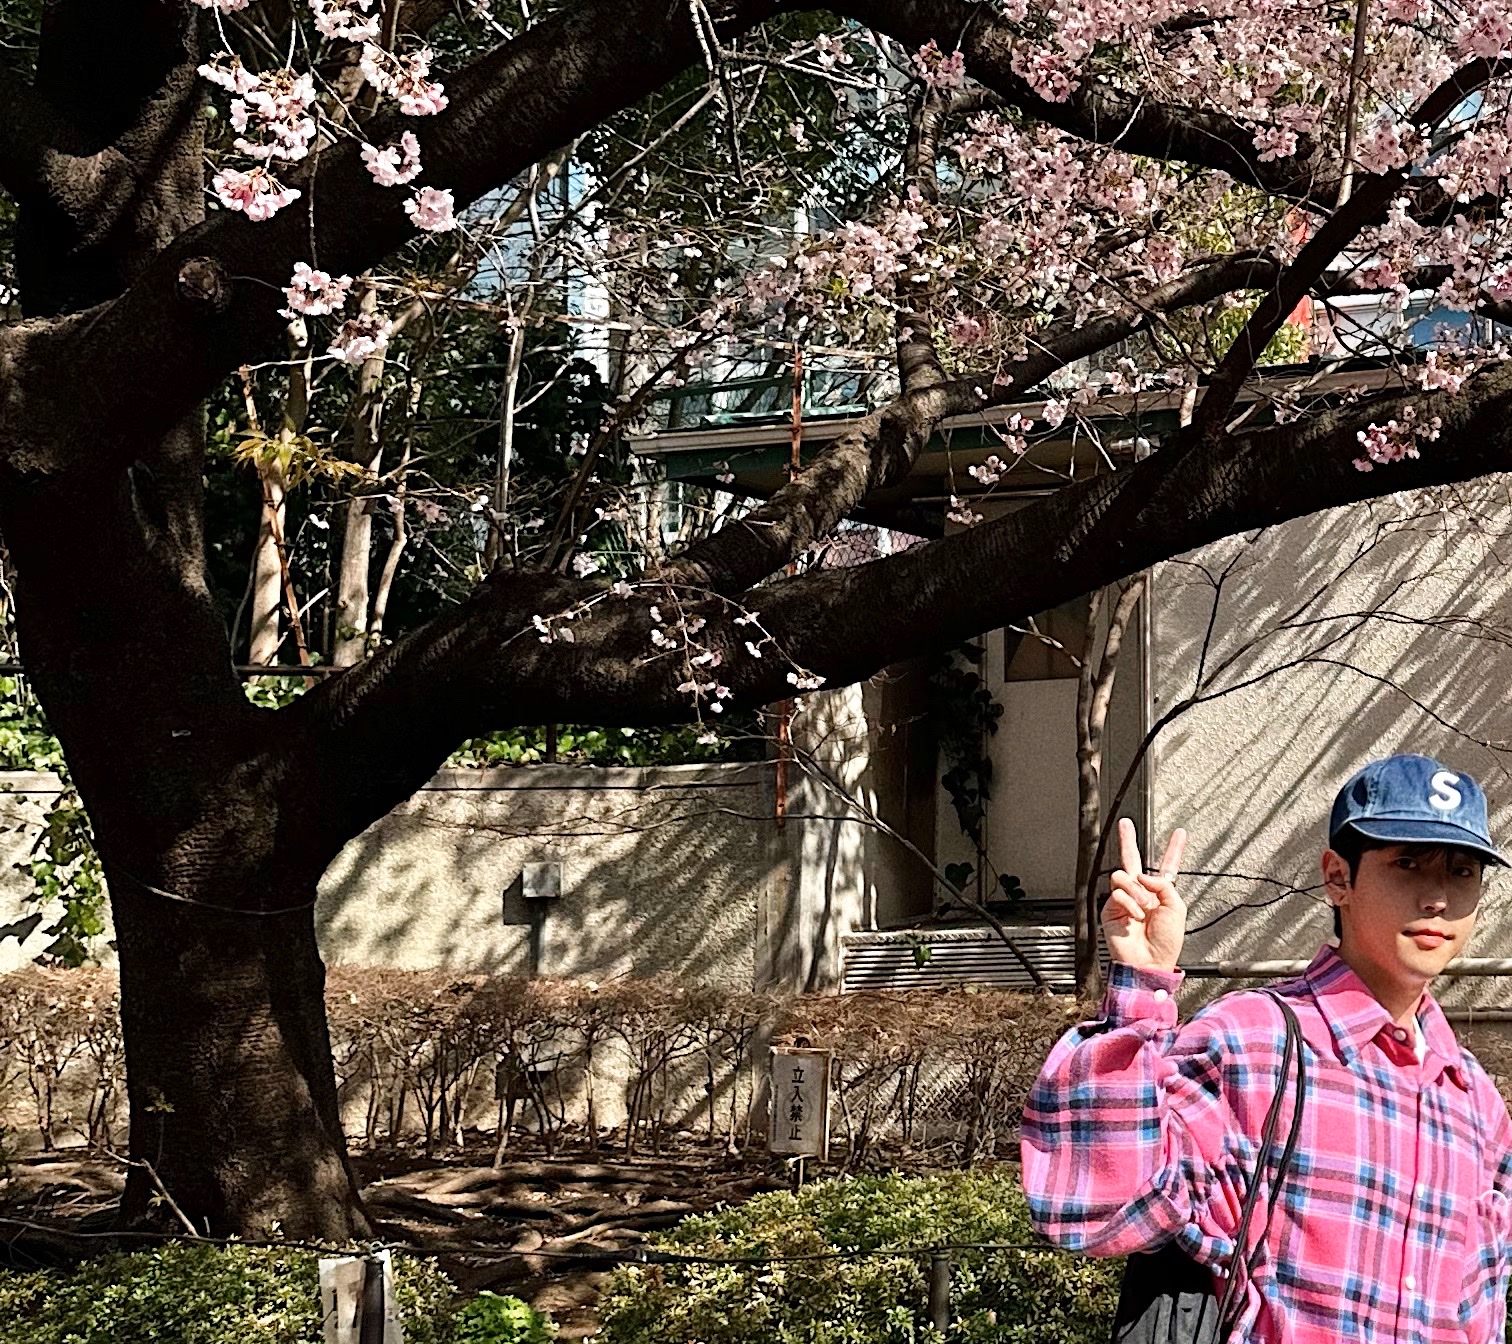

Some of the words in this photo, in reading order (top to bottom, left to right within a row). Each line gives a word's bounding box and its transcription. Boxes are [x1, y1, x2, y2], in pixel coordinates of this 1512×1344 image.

[1429, 771, 1462, 810] S
[788, 1066, 805, 1141] 立入禁止
